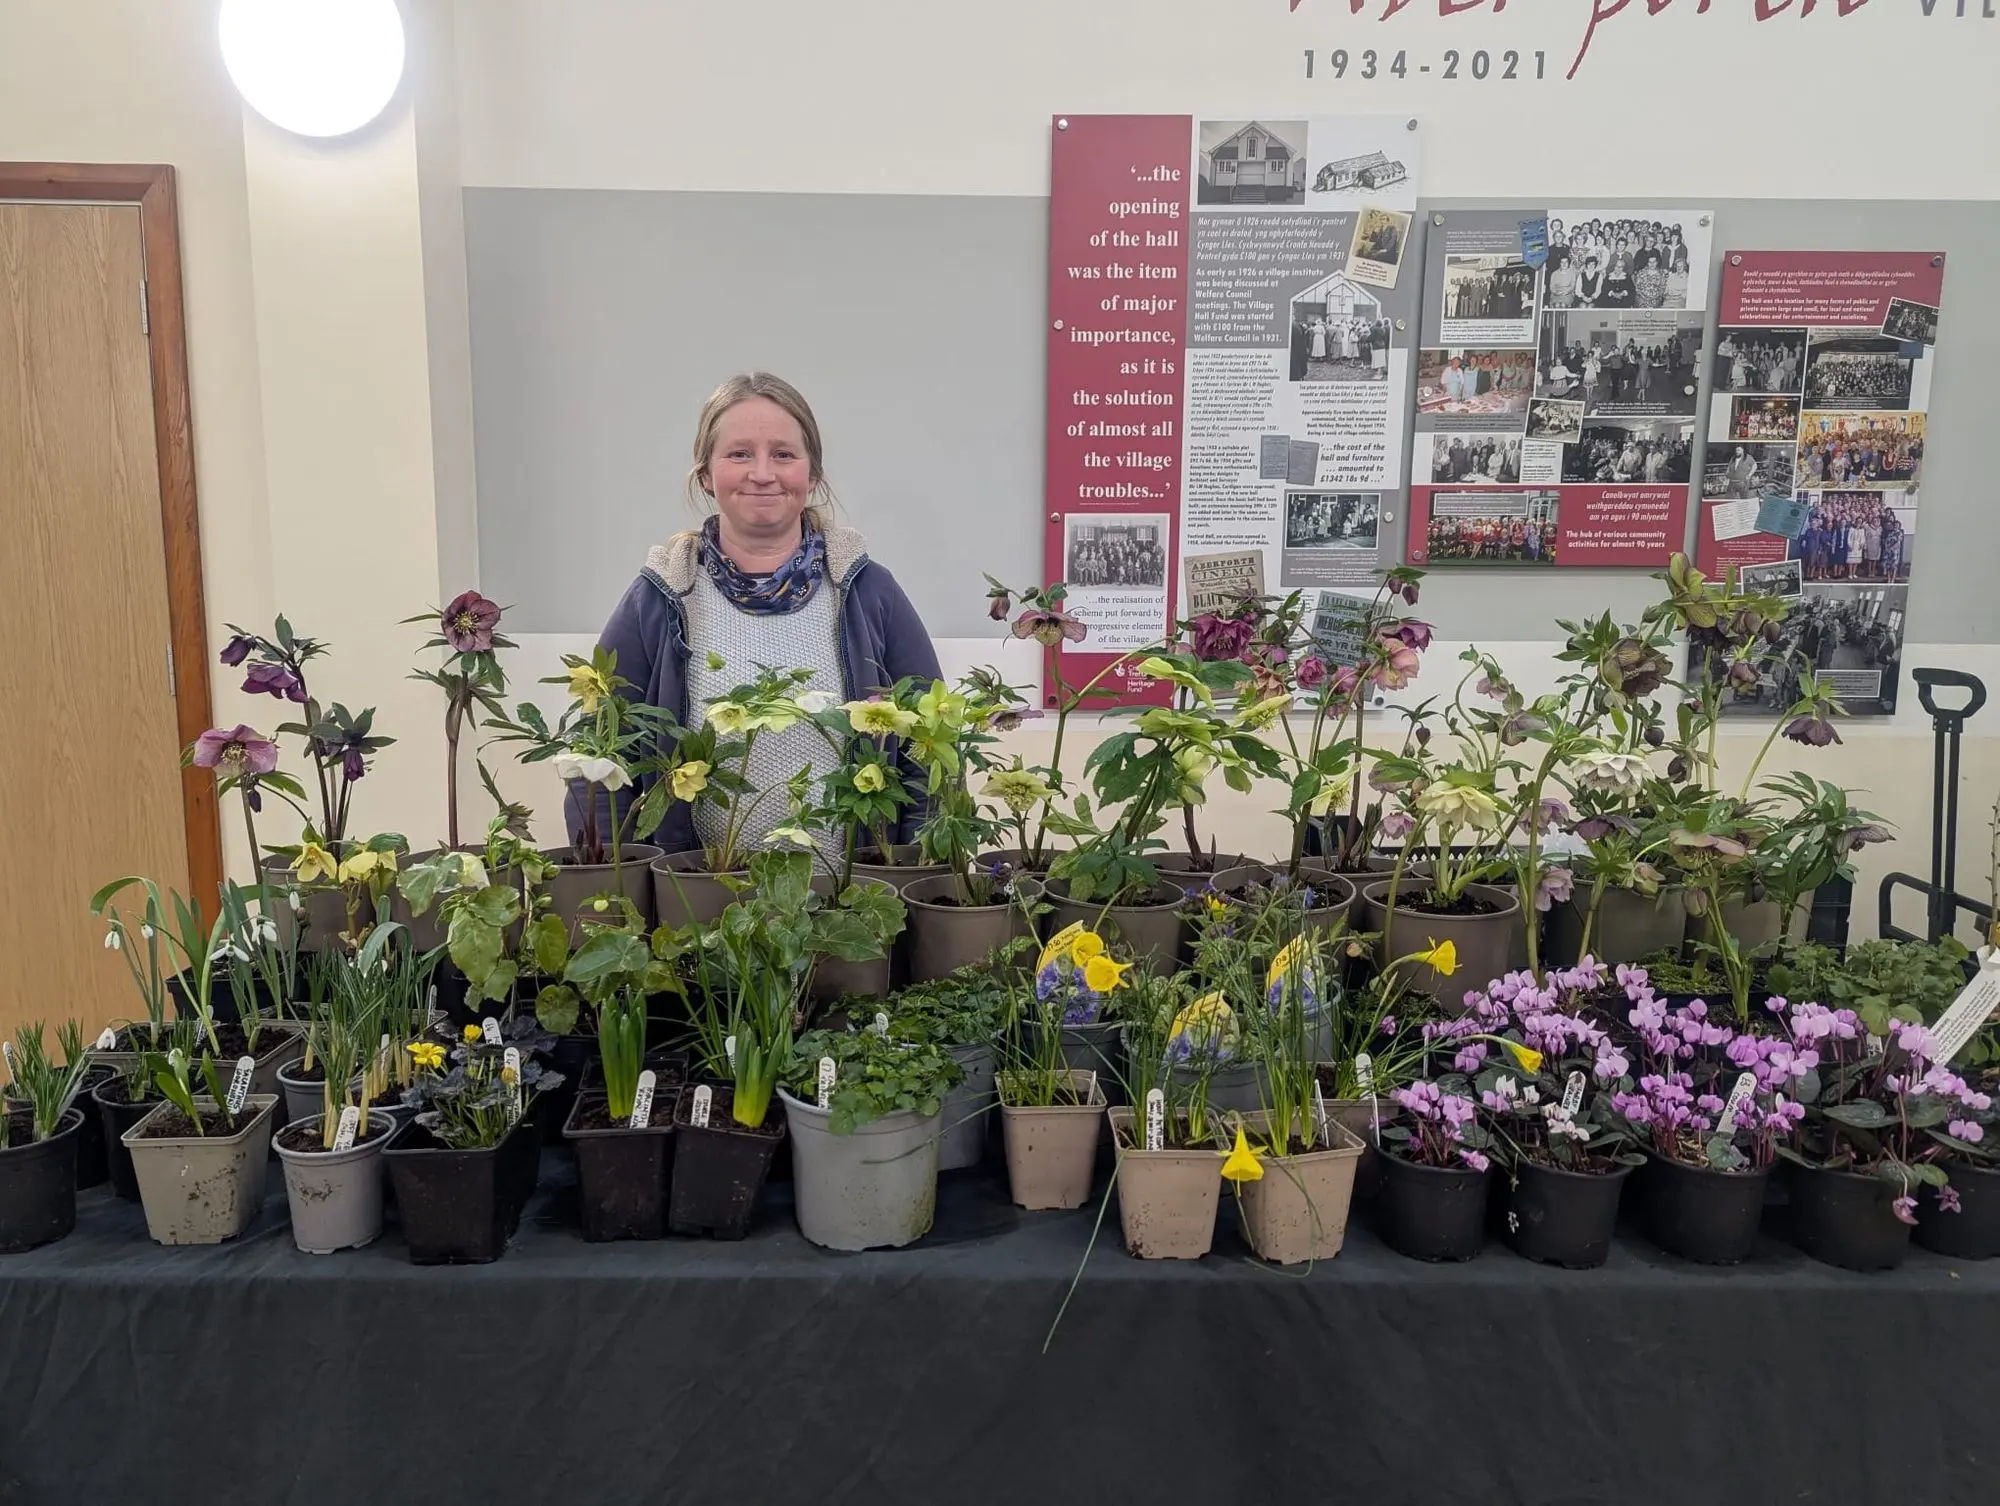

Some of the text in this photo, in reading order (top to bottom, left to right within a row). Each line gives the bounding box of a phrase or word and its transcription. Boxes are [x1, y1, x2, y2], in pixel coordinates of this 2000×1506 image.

[1303, 50, 1546, 79] 1934-2021
[1109, 198, 1179, 218] opening
[1090, 230, 1178, 246] of the hall
[1069, 263, 1176, 278] was the item
[1207, 268, 1225, 277] early
[1265, 268, 1289, 277] village
[1212, 280, 1232, 289] being
[1101, 295, 1177, 314] of major
[1195, 301, 1229, 310] meetings.
[1248, 301, 1273, 310] Village
[1071, 327, 1174, 346] importance,
[1120, 358, 1174, 373] as it is
[1073, 390, 1172, 405] the solution
[1067, 421, 1172, 435] of almost all
[1084, 452, 1171, 471] the village
[1629, 530, 1665, 539] community
[1192, 567, 1256, 580] CINEMA
[1105, 609, 1117, 618] put
[1153, 609, 1163, 618] by
